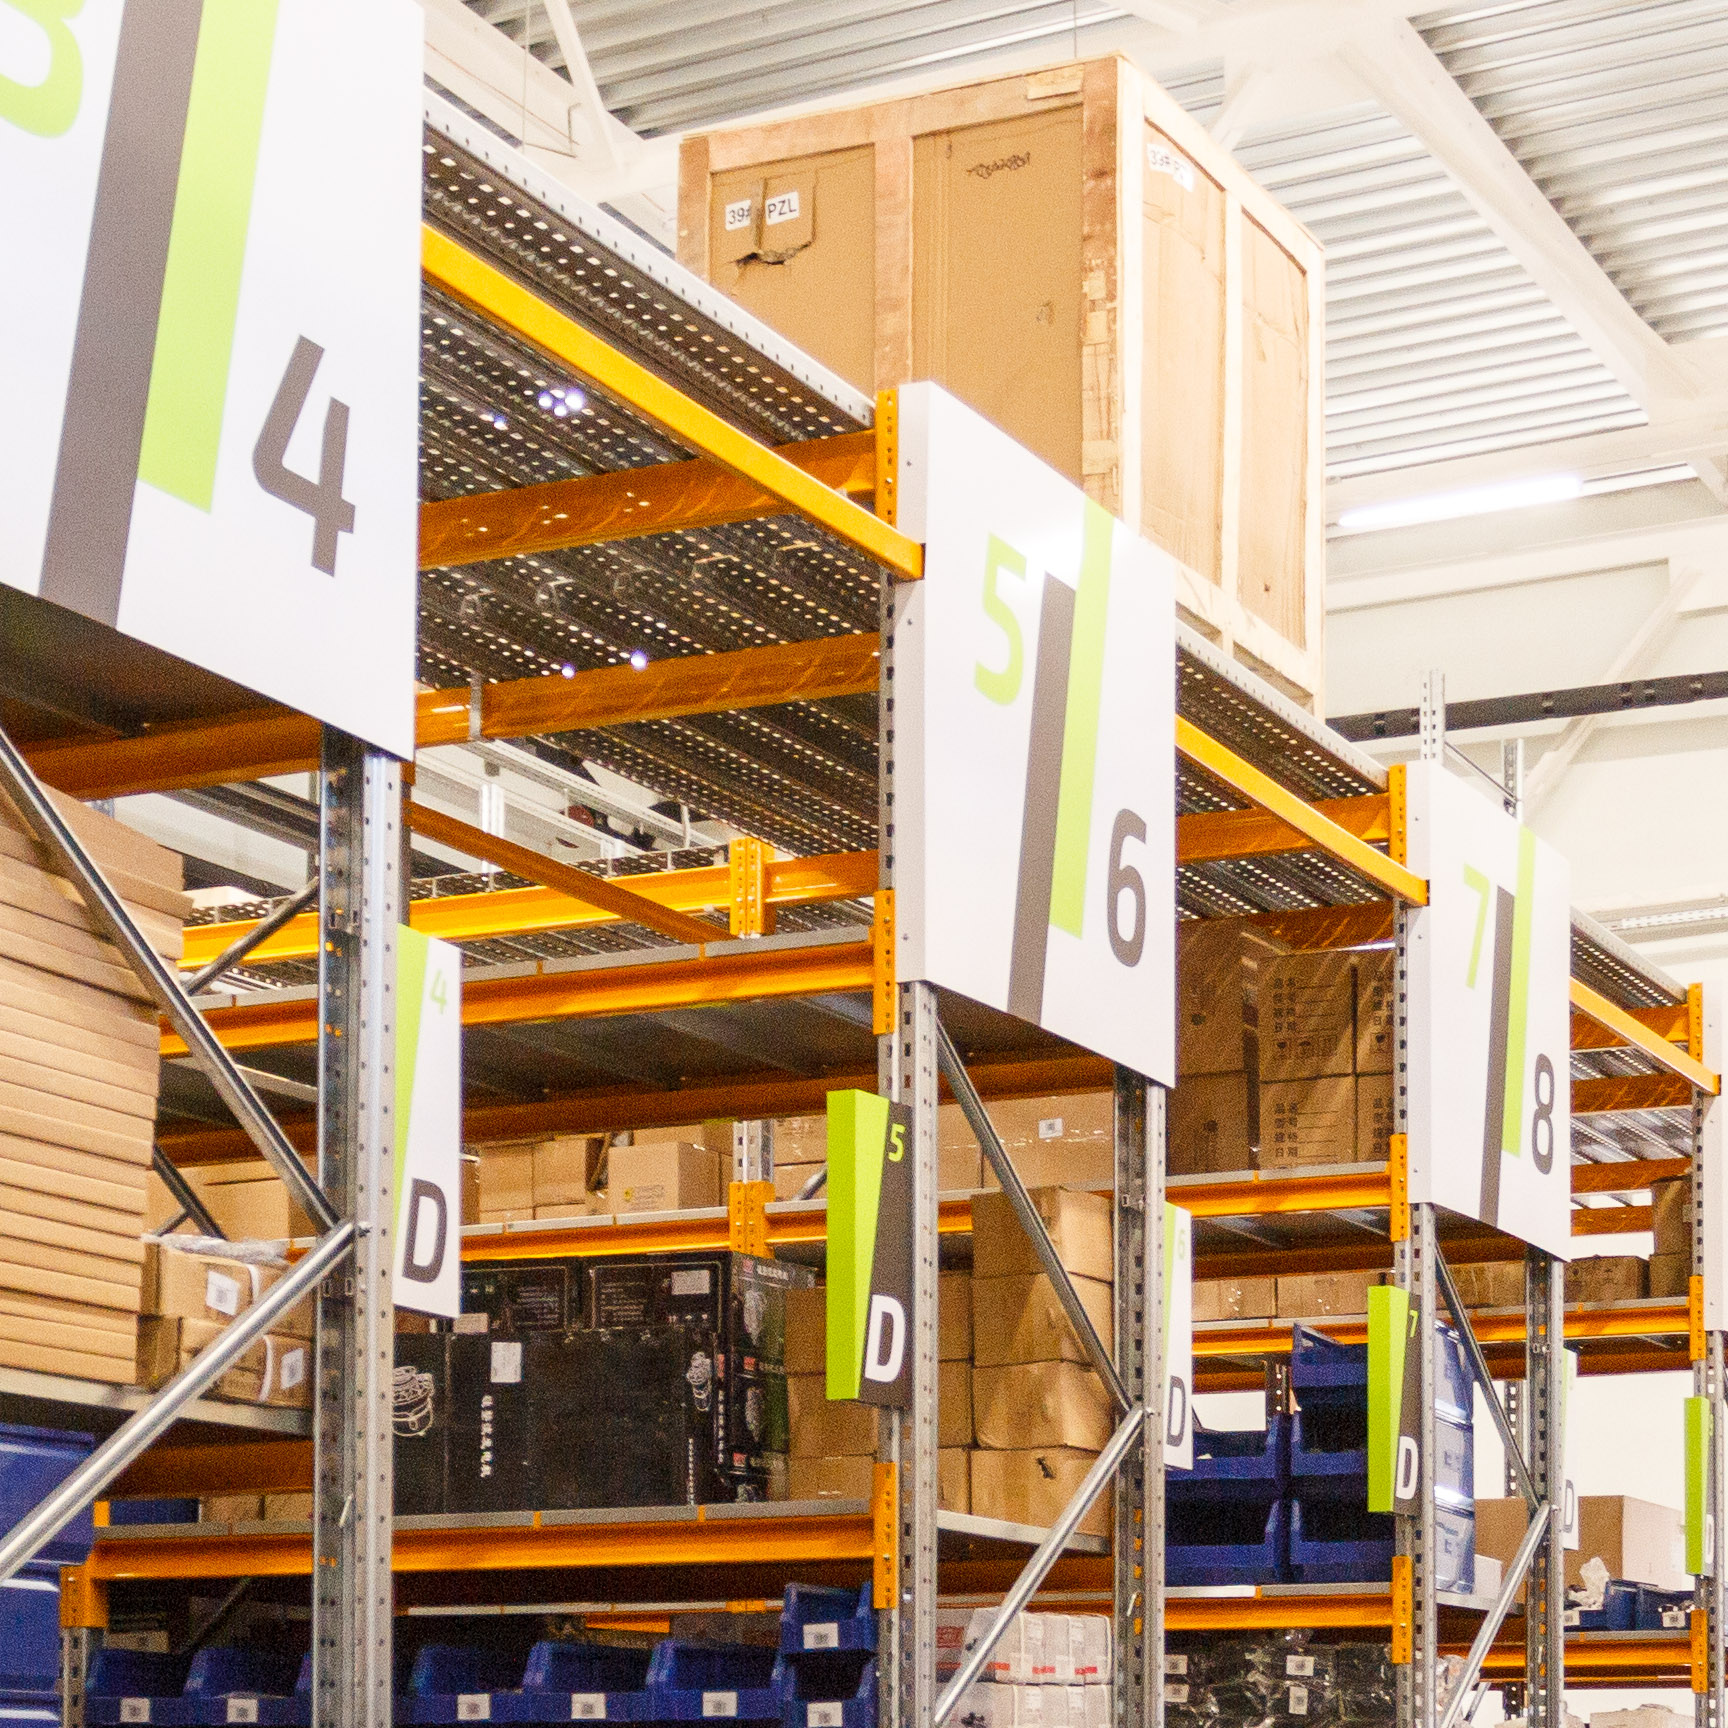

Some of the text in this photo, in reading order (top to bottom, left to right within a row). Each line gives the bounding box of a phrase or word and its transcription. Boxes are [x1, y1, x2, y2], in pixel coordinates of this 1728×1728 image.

[767, 198, 797, 219] PZL
[252, 334, 356, 578] 4
[974, 532, 1029, 705] 5
[1107, 808, 1147, 968] 6
[1463, 863, 1489, 990] 7
[429, 968, 449, 1014] 4
[887, 1124, 906, 1165] 5
[1531, 1053, 1555, 1175] 8
[402, 1177, 449, 1285] D
[1177, 1231, 1185, 1260] 6
[864, 1293, 907, 1384] D
[1409, 1309, 1419, 1338] 7
[1166, 1375, 1187, 1447] D
[1395, 1436, 1420, 1500] D
